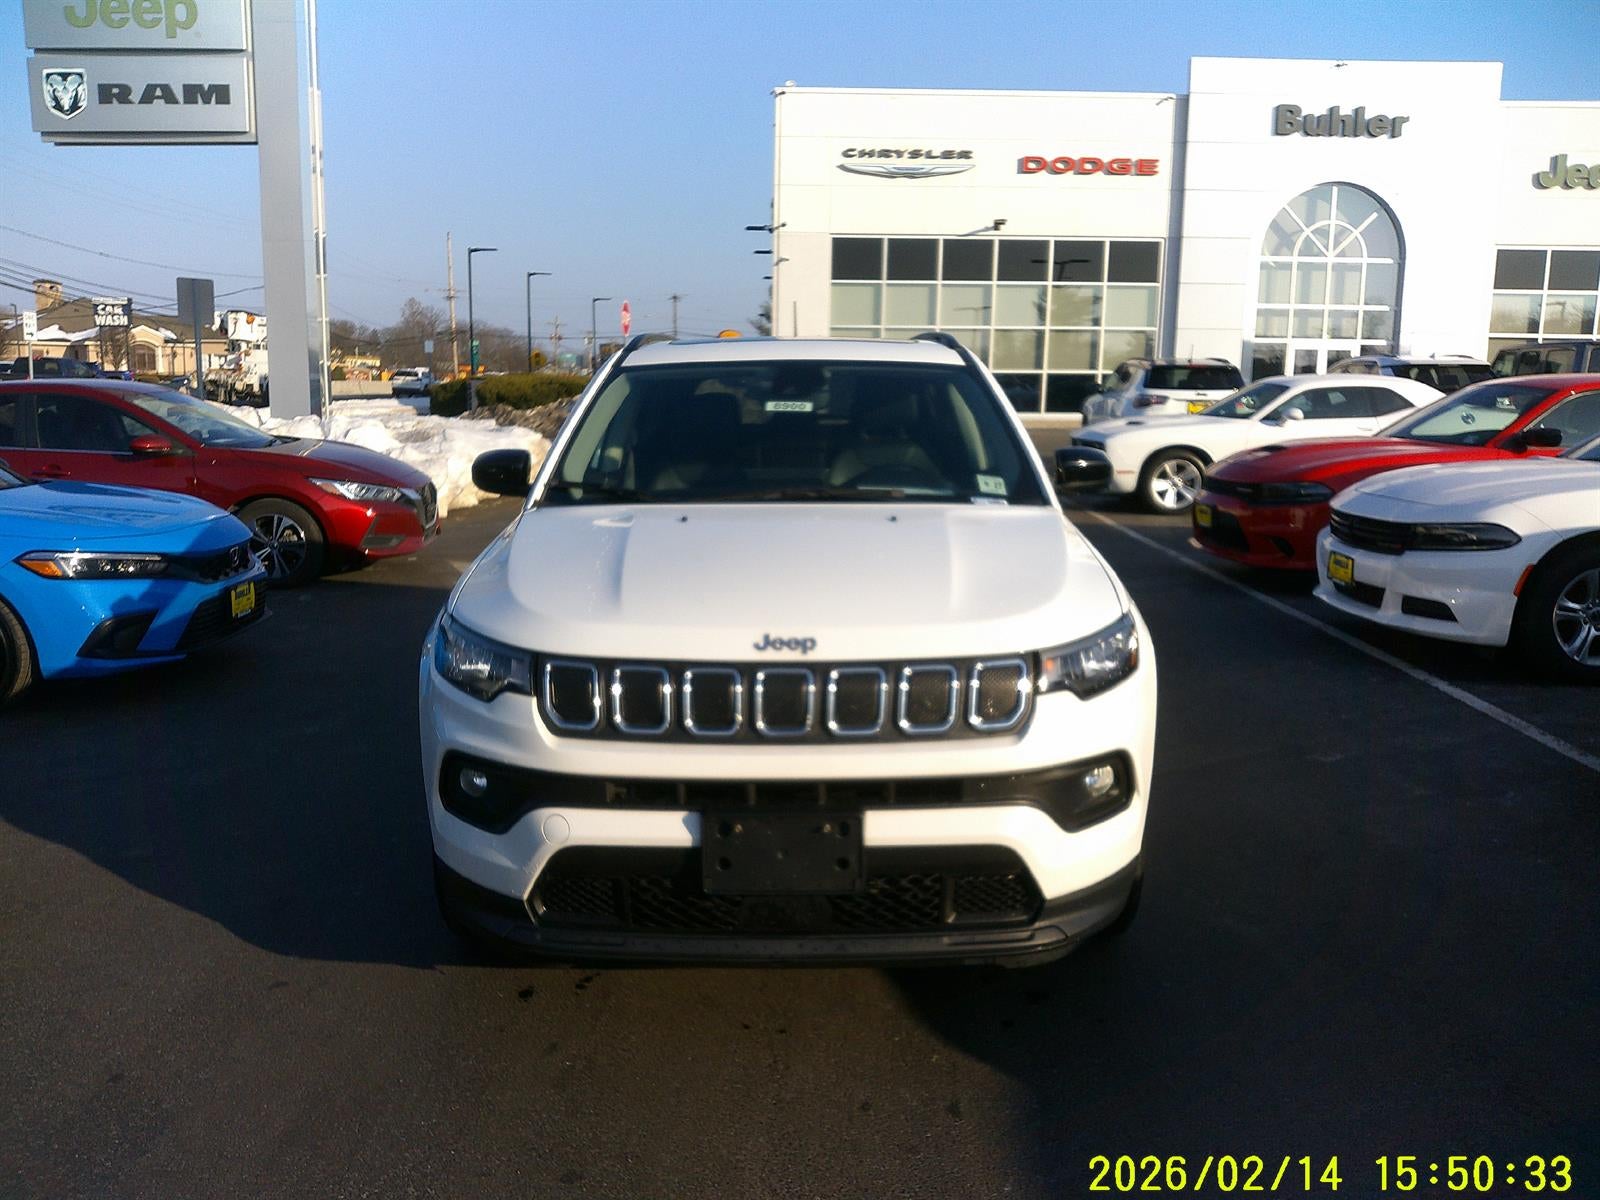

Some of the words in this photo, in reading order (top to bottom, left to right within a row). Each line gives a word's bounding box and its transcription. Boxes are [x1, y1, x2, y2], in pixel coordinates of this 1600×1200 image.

[63, 0, 199, 39] Jeep
[97, 83, 231, 105] RAM
[1271, 104, 1410, 138] Buhler
[841, 148, 974, 160] CHRYSLER
[1018, 156, 1160, 176] DODGE
[95, 314, 129, 326] WASH
[97, 304, 124, 315] CAR
[753, 633, 817, 655] Jeep
